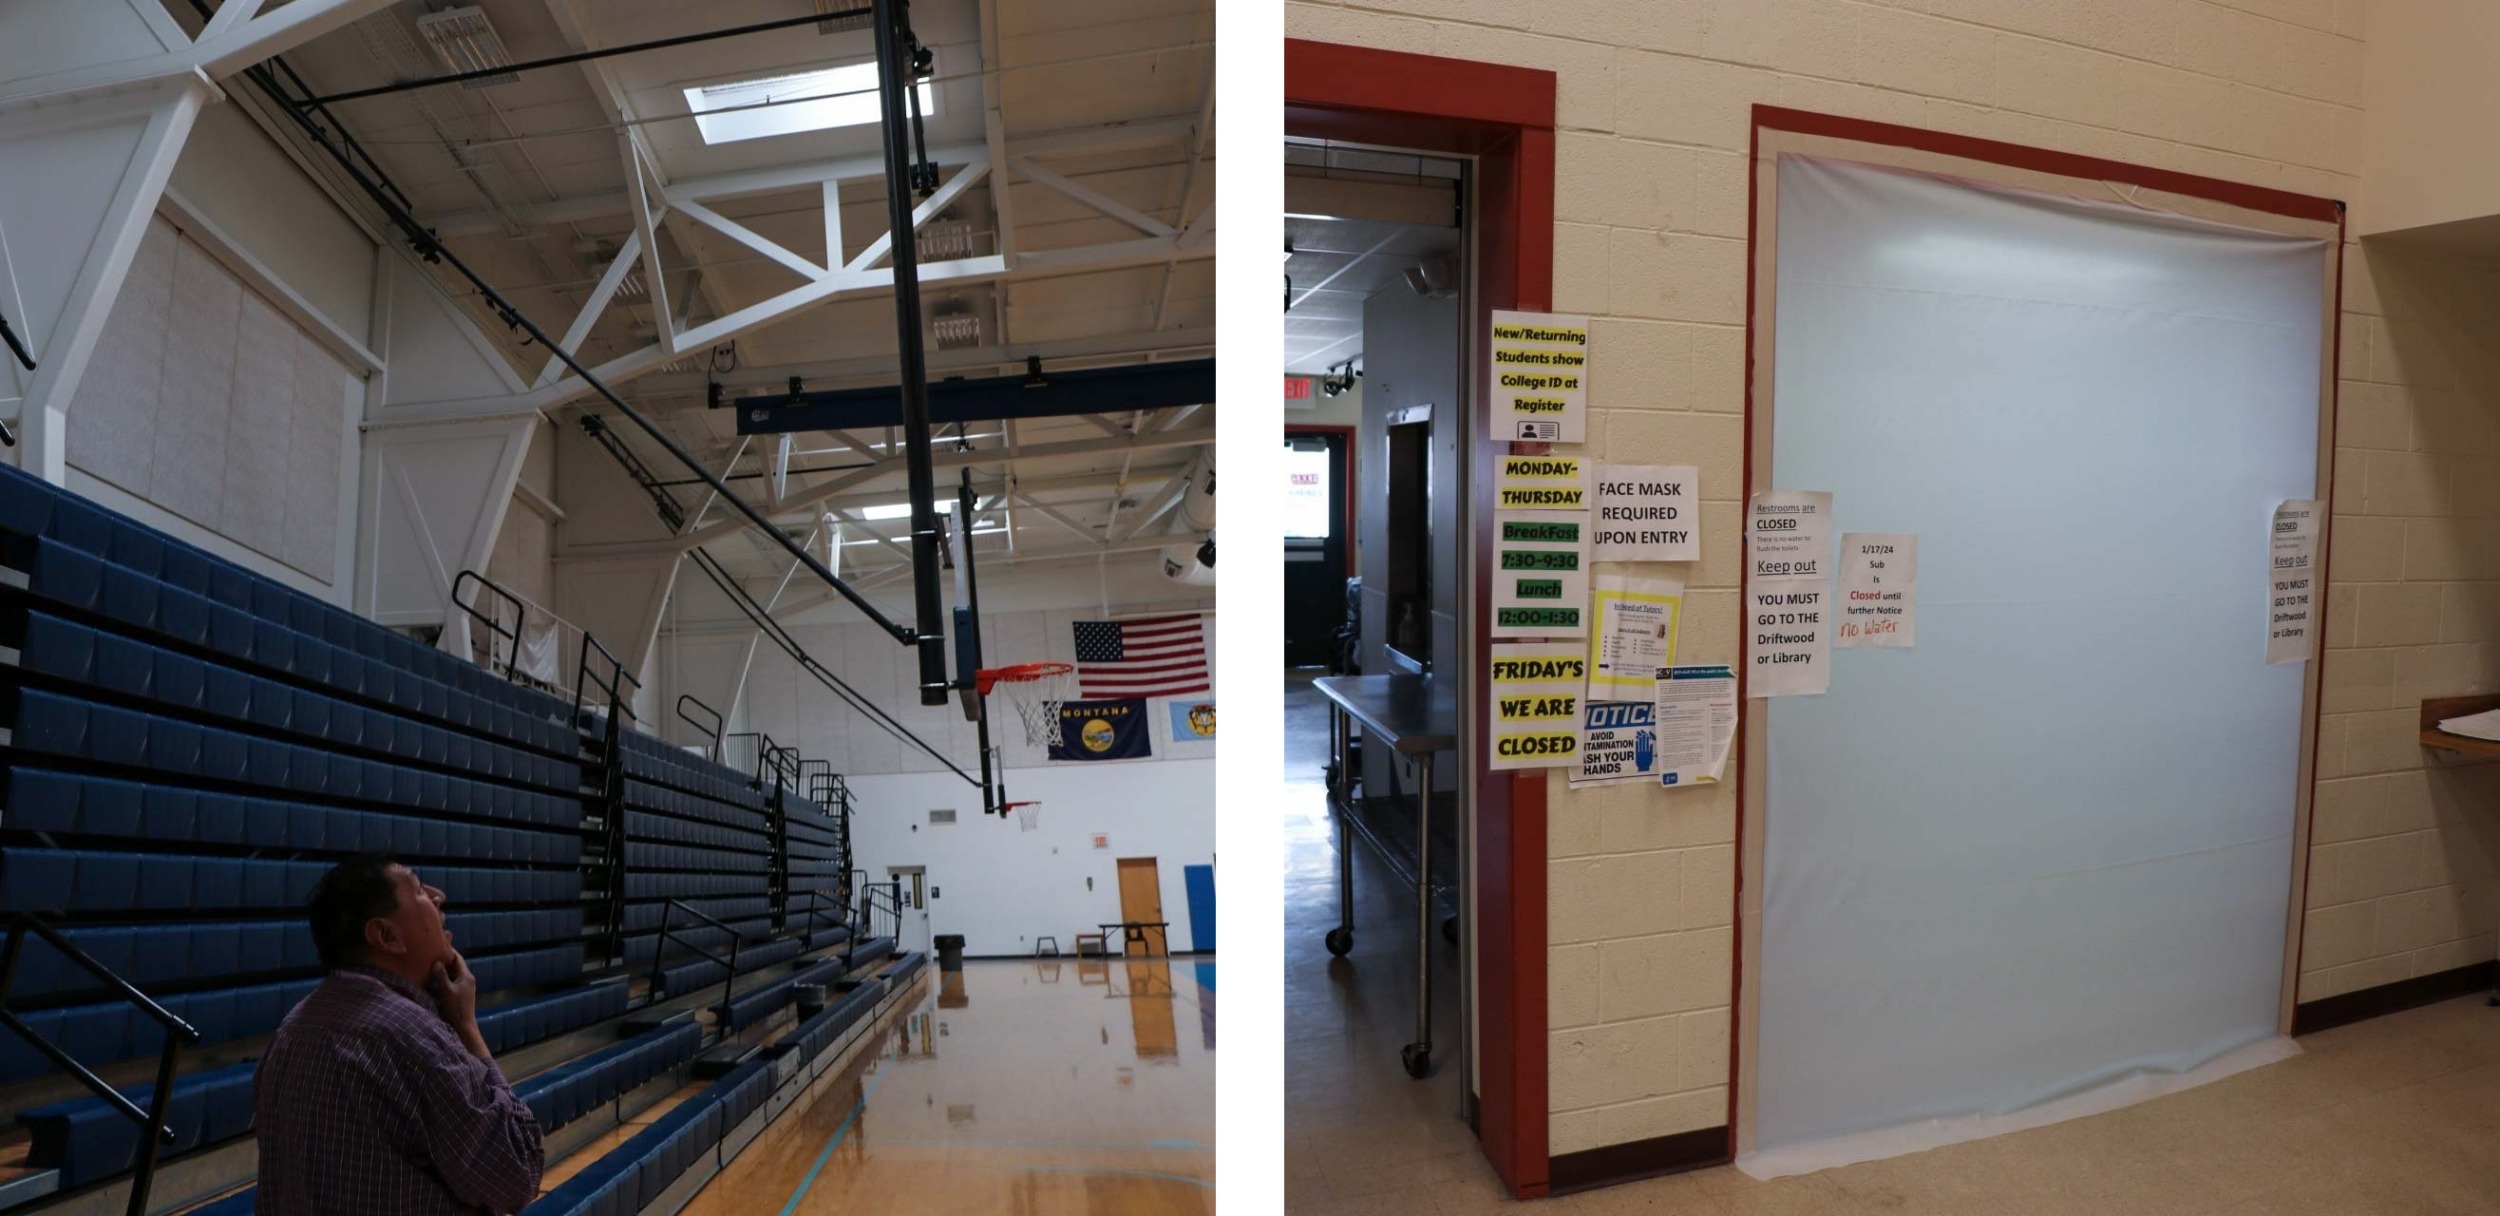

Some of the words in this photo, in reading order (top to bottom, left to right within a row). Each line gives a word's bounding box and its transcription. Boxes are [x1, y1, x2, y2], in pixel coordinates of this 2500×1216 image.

[1494, 327, 1586, 346] New/Returning
[1496, 351, 1550, 364] Students
[1552, 354, 1584, 365] show
[1501, 375, 1546, 390] College
[1549, 377, 1562, 388] ID
[1565, 378, 1578, 389] at
[1514, 399, 1565, 413] Register
[1506, 461, 1578, 475] MONDAY-
[1599, 483, 1634, 496] FACE
[1639, 483, 1681, 496] MASK
[1502, 491, 1583, 504] THURSDAY
[1602, 507, 1677, 521] REQUIRED
[1757, 504, 1800, 514] Restrooms
[1802, 504, 1816, 513] are
[1757, 518, 1797, 530] CLOSED
[1594, 531, 1636, 544] UPON
[1641, 531, 1688, 544] ENTRY
[1862, 545, 1894, 554] 1/17/24
[1502, 554, 1578, 568] 7:30-9:30
[1757, 560, 1791, 575] Keep
[1794, 559, 1816, 573] out
[1870, 560, 1885, 569] Sub
[1516, 581, 1562, 596] Lunch
[2275, 581, 2289, 591] YOU
[2290, 579, 2309, 590] MUST
[1758, 594, 1783, 605] YOU
[1787, 593, 1820, 605] MUST
[1850, 590, 1881, 600] Closed
[1883, 592, 1902, 600] until
[2274, 598, 2285, 607] GO
[2286, 597, 2296, 606] TO
[1847, 606, 1875, 615] further
[1877, 606, 1902, 615] Notice
[2274, 611, 2306, 623] Driftwood
[1498, 610, 1579, 625] 12:00-1:30
[1758, 614, 1776, 625] GO
[1779, 613, 1795, 624] TO
[1798, 612, 1819, 624] THE
[1758, 632, 1815, 645] Driftwood
[2273, 631, 2280, 639] or
[2281, 627, 2304, 638] Library
[1757, 655, 1770, 664] or
[1773, 651, 1811, 666] Library
[1493, 660, 1584, 679] FRIDAY'S
[1062, 706, 1129, 718] MONTANA
[1500, 700, 1529, 717] WE
[1534, 698, 1576, 716] ARE
[1590, 731, 1614, 741] AVOID
[1498, 736, 1576, 756] CLOSED
[1584, 753, 1601, 764] SH
[1604, 751, 1635, 762] YOUR
[1584, 763, 1622, 775] HANDS
